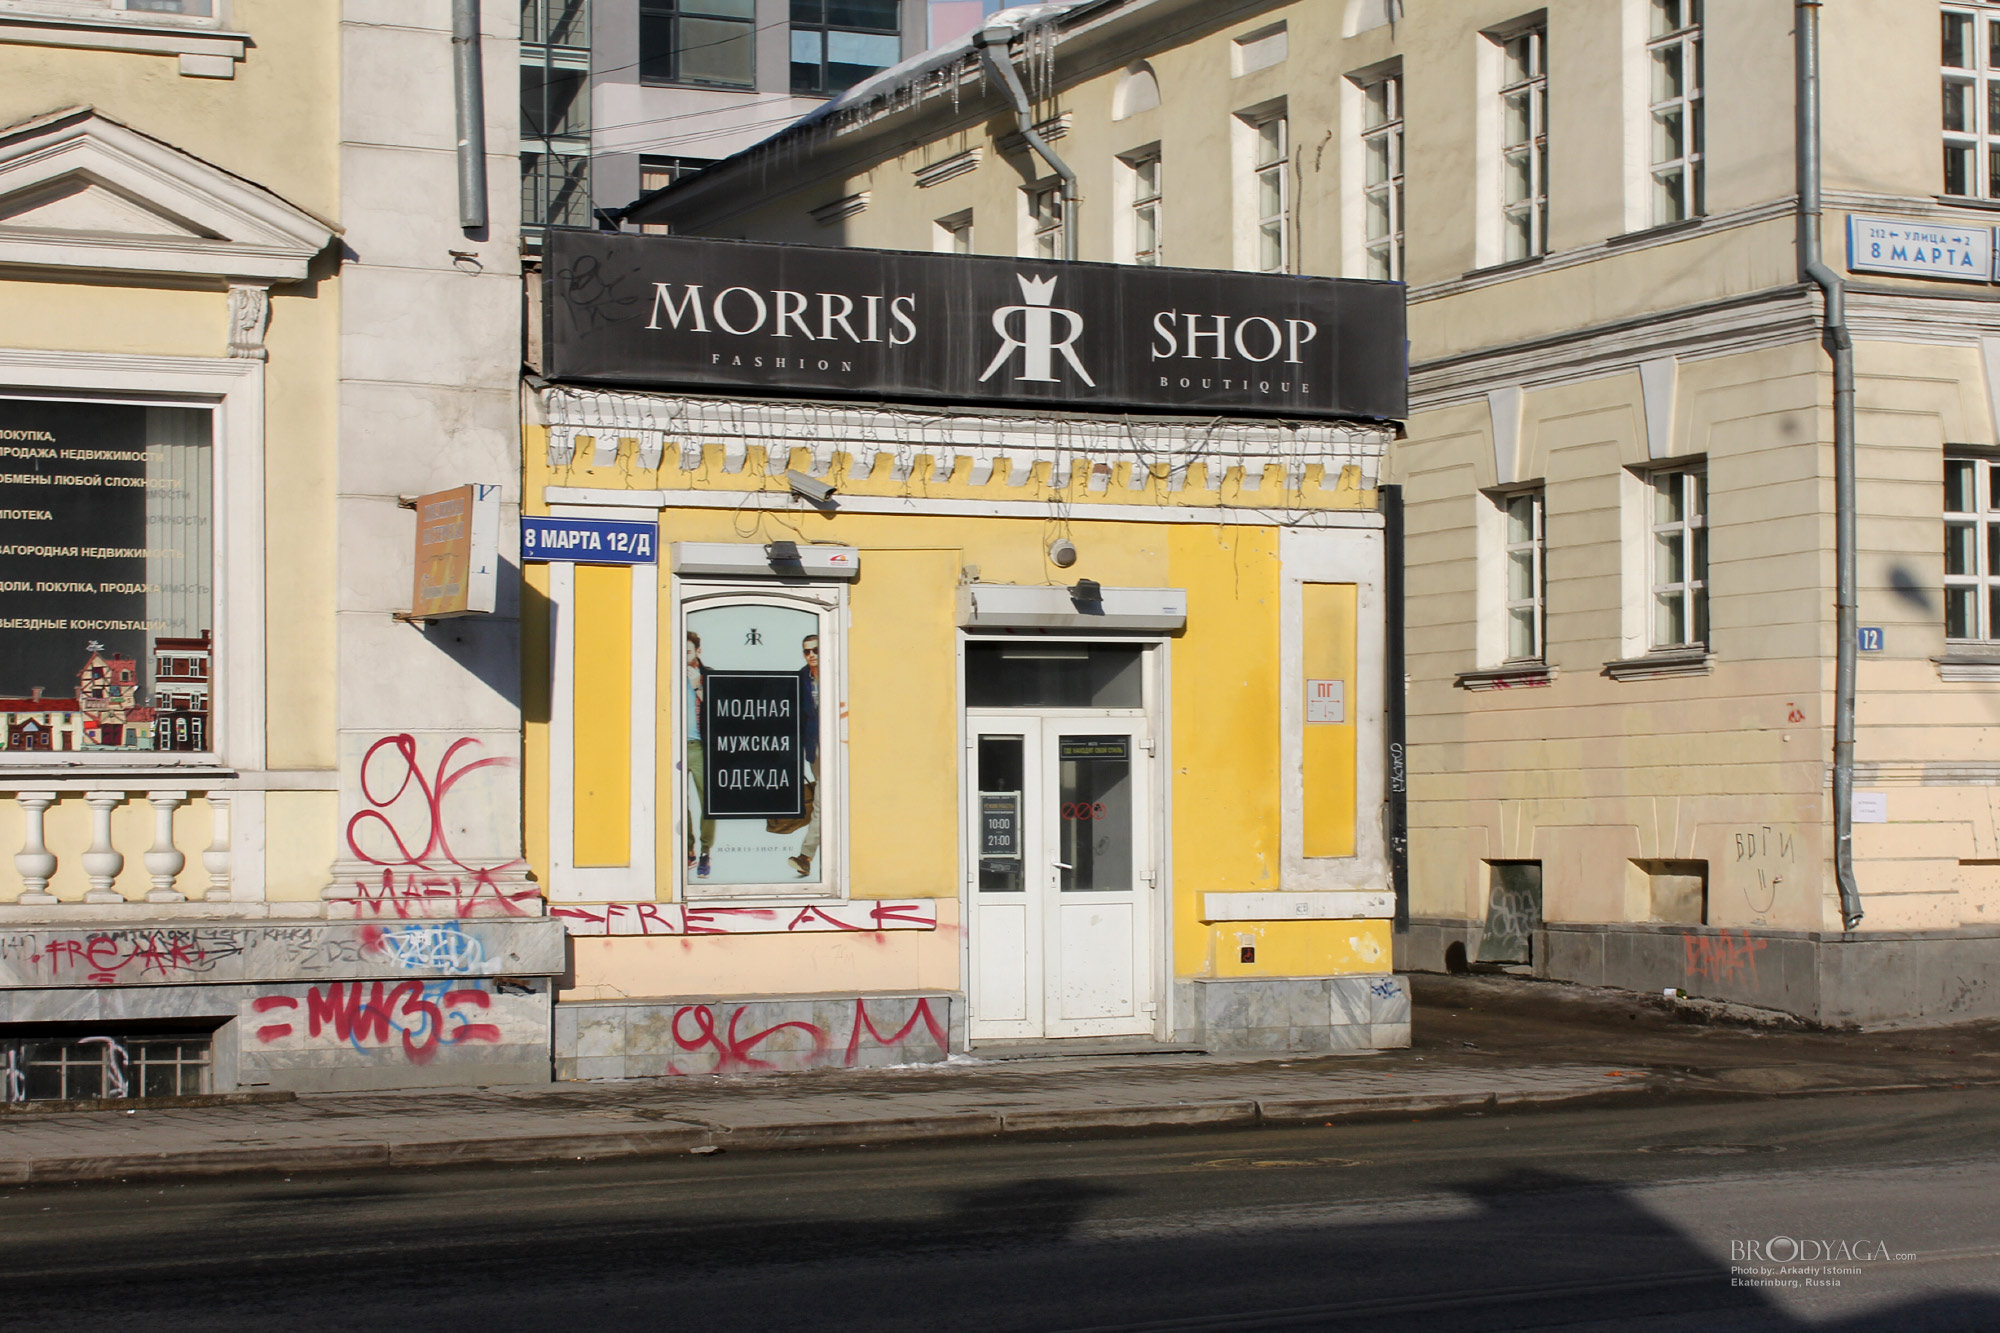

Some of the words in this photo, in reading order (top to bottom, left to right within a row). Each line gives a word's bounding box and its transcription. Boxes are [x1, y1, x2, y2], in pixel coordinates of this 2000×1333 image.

[1870, 228, 1886, 239] 212
[1904, 231, 1947, 245] УЛИЦА
[1964, 235, 1971, 247] 2
[1871, 242, 1881, 259] 8
[1891, 244, 1974, 267] МАРТА
[644, 281, 917, 349] MORRIS
[1151, 308, 1318, 365] SHOP
[711, 353, 853, 373] FASHION
[1160, 376, 1310, 395] BOUTIQUE
[60, 449, 164, 462] НЕДВИЖИМОСТИ
[54, 475, 101, 487] ЛЮБОЙ
[104, 477, 182, 489] СЛОЖНОСТИ
[525, 528, 537, 548] 8
[541, 529, 601, 550] МАРТА
[606, 532, 651, 556] 12/Д
[0, 545, 78, 557] АГОРОДНАЯ
[81, 547, 184, 559] НЕДВИЖИМОСТЬ
[36, 582, 97, 594] ПОКУПКА,
[100, 583, 160, 595] ПРОДАЖА
[70, 620, 167, 632] КОНСУЛЬТАЦИИ
[1863, 629, 1878, 650] 12
[1317, 682, 1333, 698] ПГ
[717, 698, 790, 720] МОДНАЯ
[717, 736, 790, 754] МУЖСКАЯ
[718, 768, 790, 791] ОДЕЖДА
[988, 818, 1010, 829] 10:00
[988, 835, 1010, 846] 21:00
